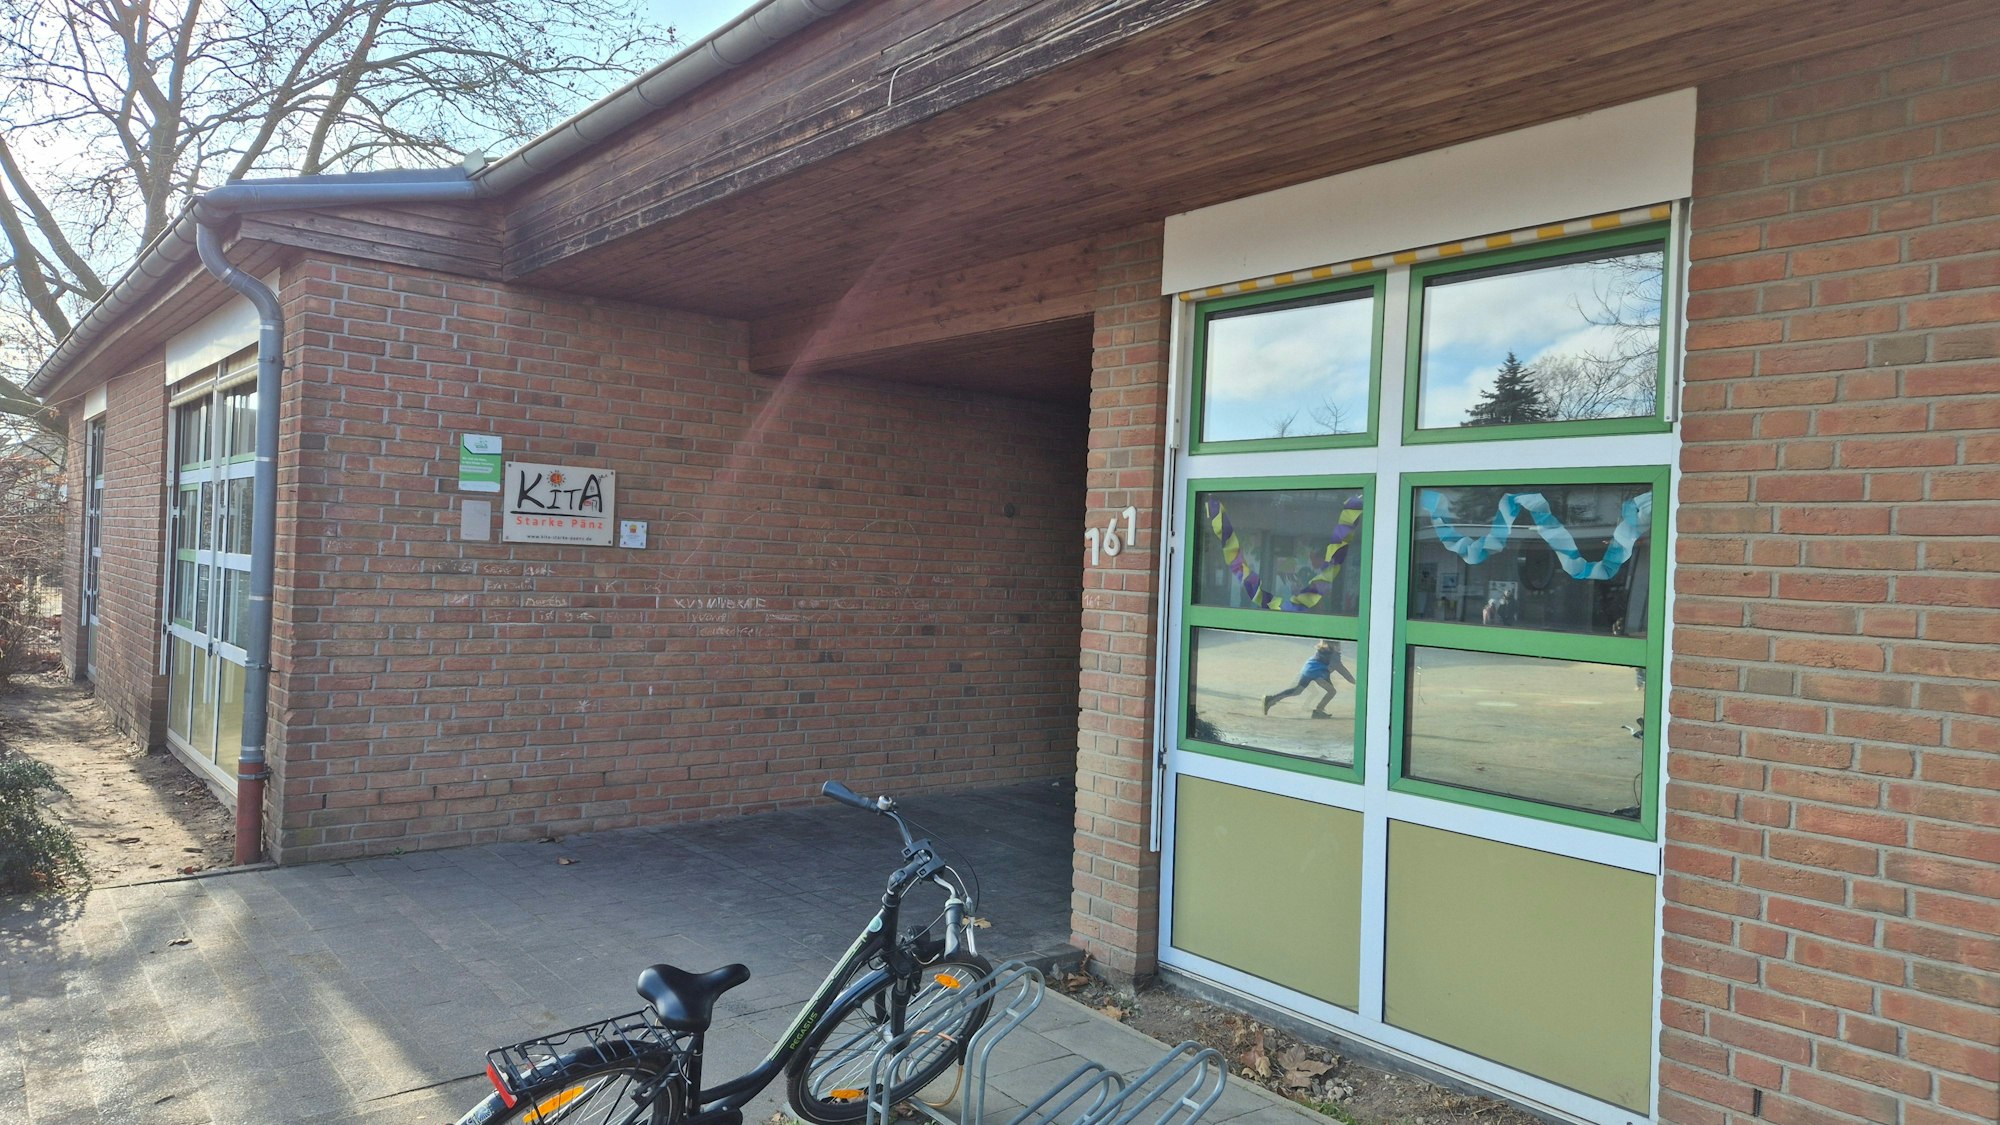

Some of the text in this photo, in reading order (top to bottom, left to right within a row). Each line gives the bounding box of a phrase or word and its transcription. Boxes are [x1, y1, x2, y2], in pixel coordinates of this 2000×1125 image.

[516, 516, 604, 530] Starke Pänz
[1084, 506, 1137, 567] 161
[789, 1011, 818, 1050] PEGASUS
